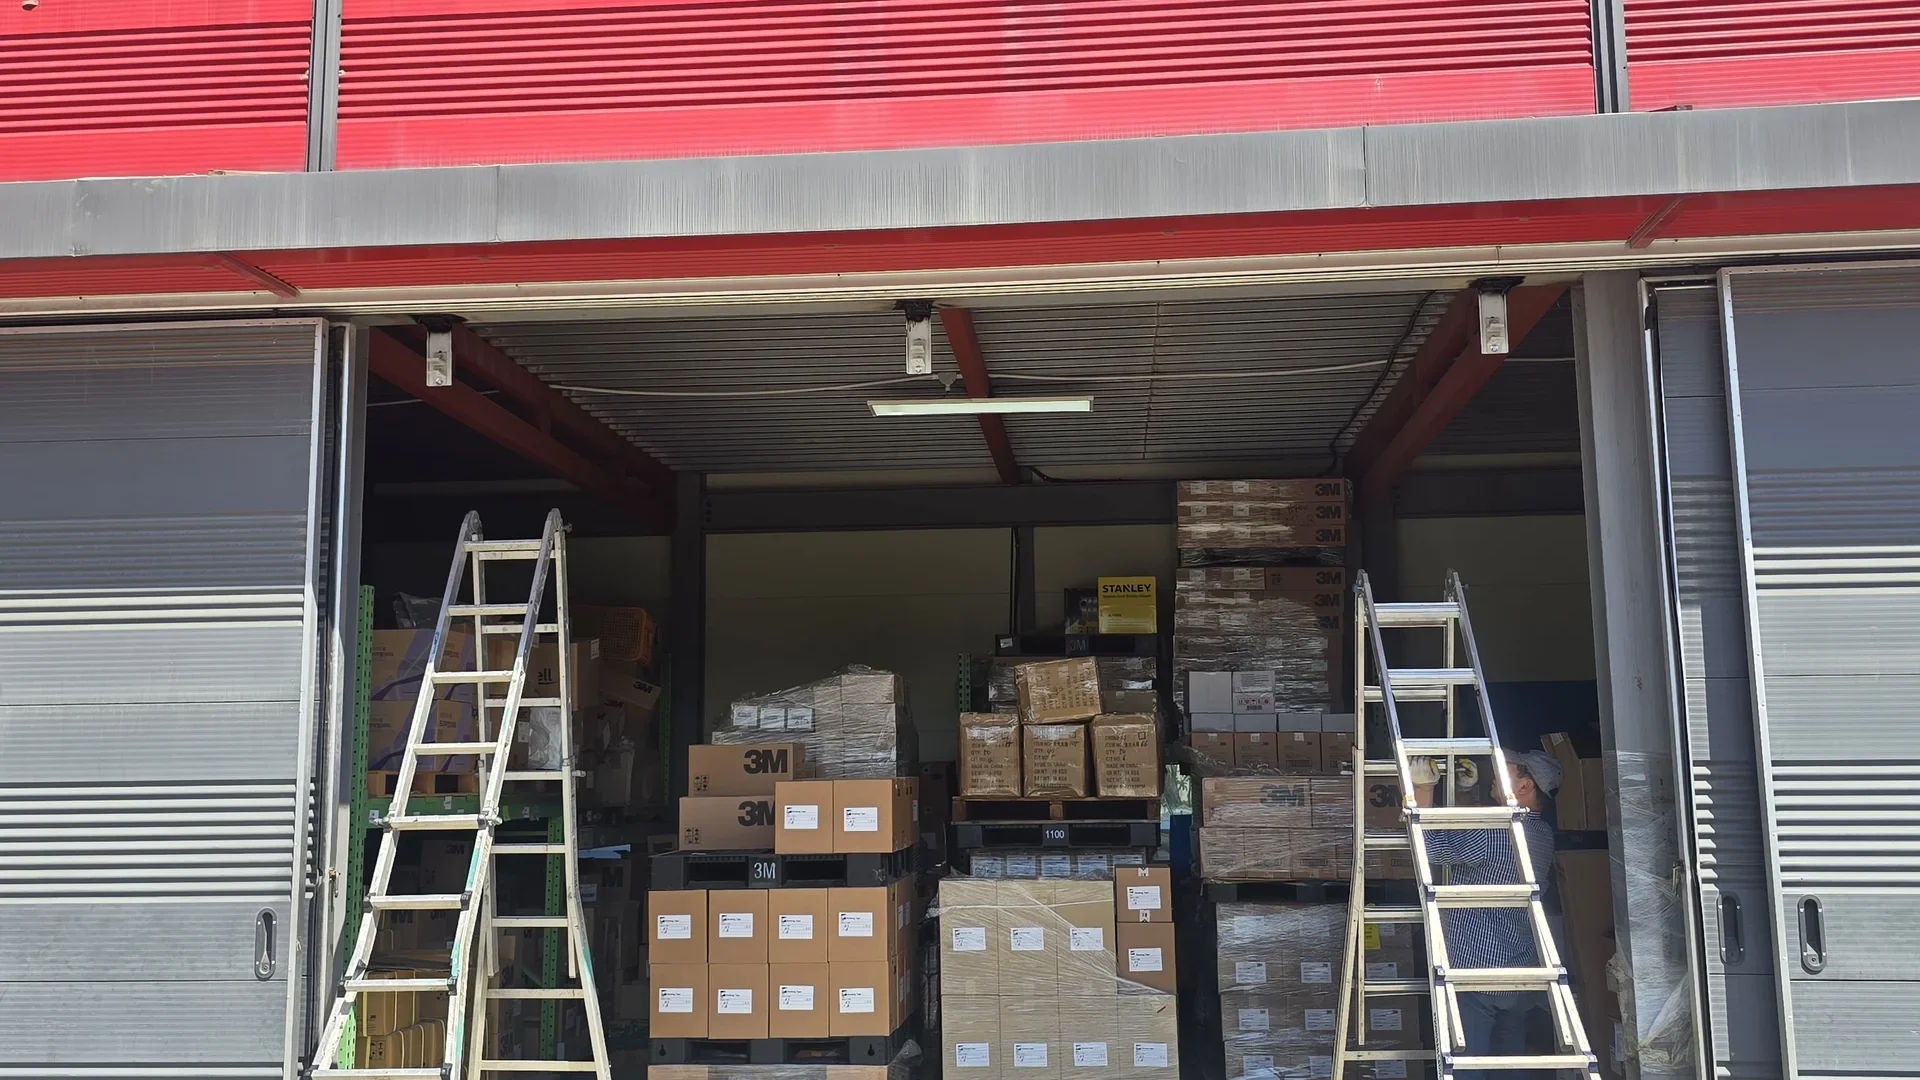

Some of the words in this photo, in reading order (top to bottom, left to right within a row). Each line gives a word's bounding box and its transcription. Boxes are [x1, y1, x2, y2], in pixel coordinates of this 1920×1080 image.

[1314, 483, 1340, 496] 3M
[1315, 506, 1341, 519] 3M
[1315, 529, 1341, 542] 3M
[1315, 572, 1341, 584] 3M
[1102, 584, 1152, 593] STANLEY
[1315, 594, 1340, 607] 3M
[1070, 640, 1086, 651] 3M
[633, 682, 653, 694] 3M
[604, 699, 624, 708] 3M
[743, 749, 788, 774] 3M
[1045, 829, 1065, 839] 1100
[446, 845, 464, 854] 3M
[753, 862, 776, 879] 3M
